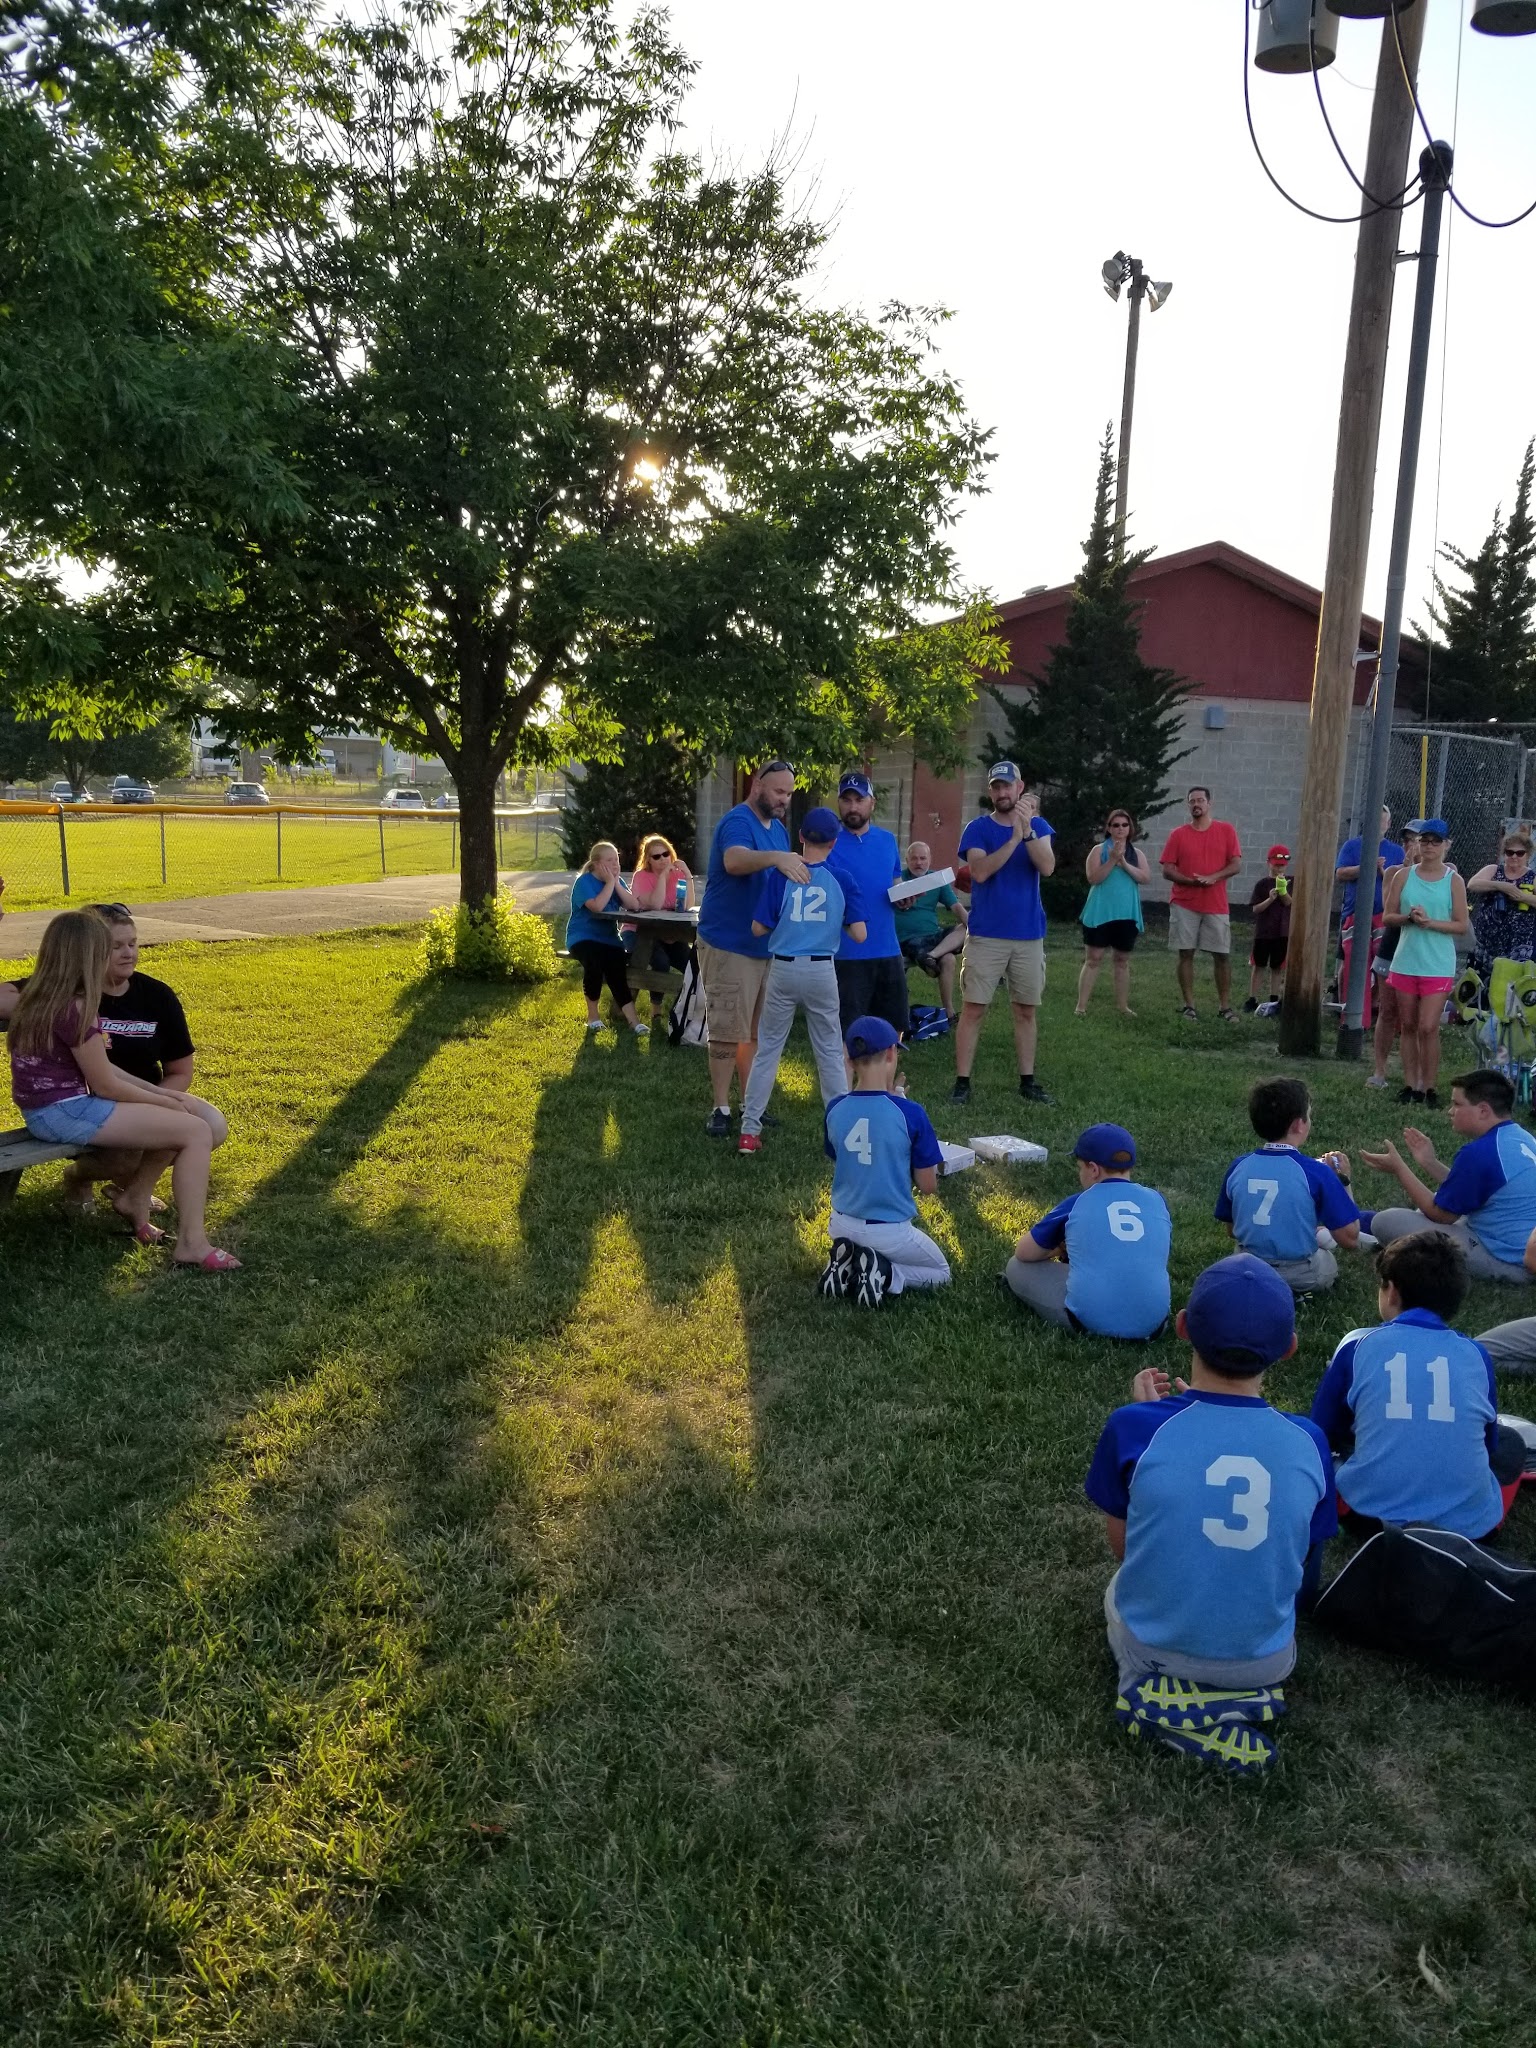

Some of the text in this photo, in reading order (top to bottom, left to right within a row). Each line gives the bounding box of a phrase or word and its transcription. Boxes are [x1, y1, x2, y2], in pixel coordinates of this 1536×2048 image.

[790, 886, 827, 922] 12
[843, 1117, 872, 1166] 4
[1106, 1200, 1145, 1242] 6
[1247, 1178, 1279, 1226] 7
[1384, 1352, 1456, 1423] 11
[1202, 1454, 1272, 1551] 3
